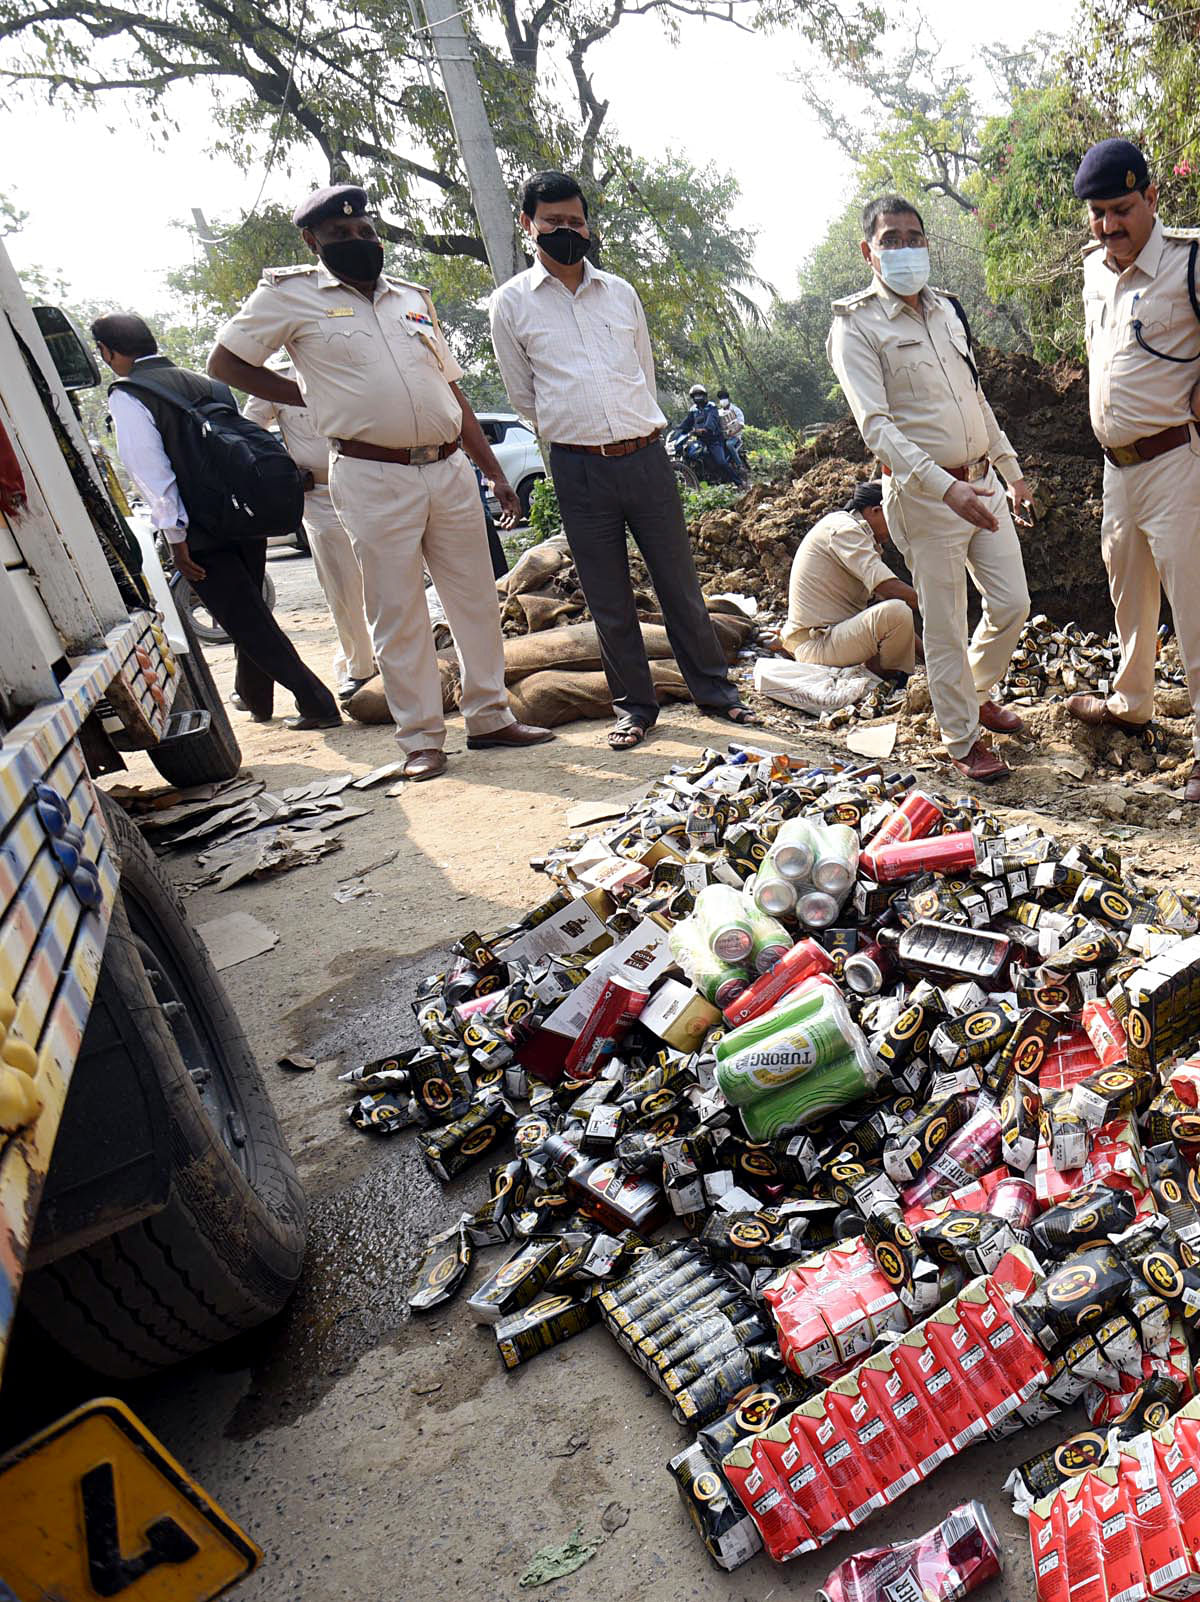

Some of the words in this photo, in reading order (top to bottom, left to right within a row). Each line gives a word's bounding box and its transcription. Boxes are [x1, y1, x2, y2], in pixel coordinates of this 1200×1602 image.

[633, 951, 655, 962] ROYAL
[628, 960, 645, 969] STAG
[750, 1051, 813, 1067] TUBORG
[938, 1157, 973, 1187] DFATHER
